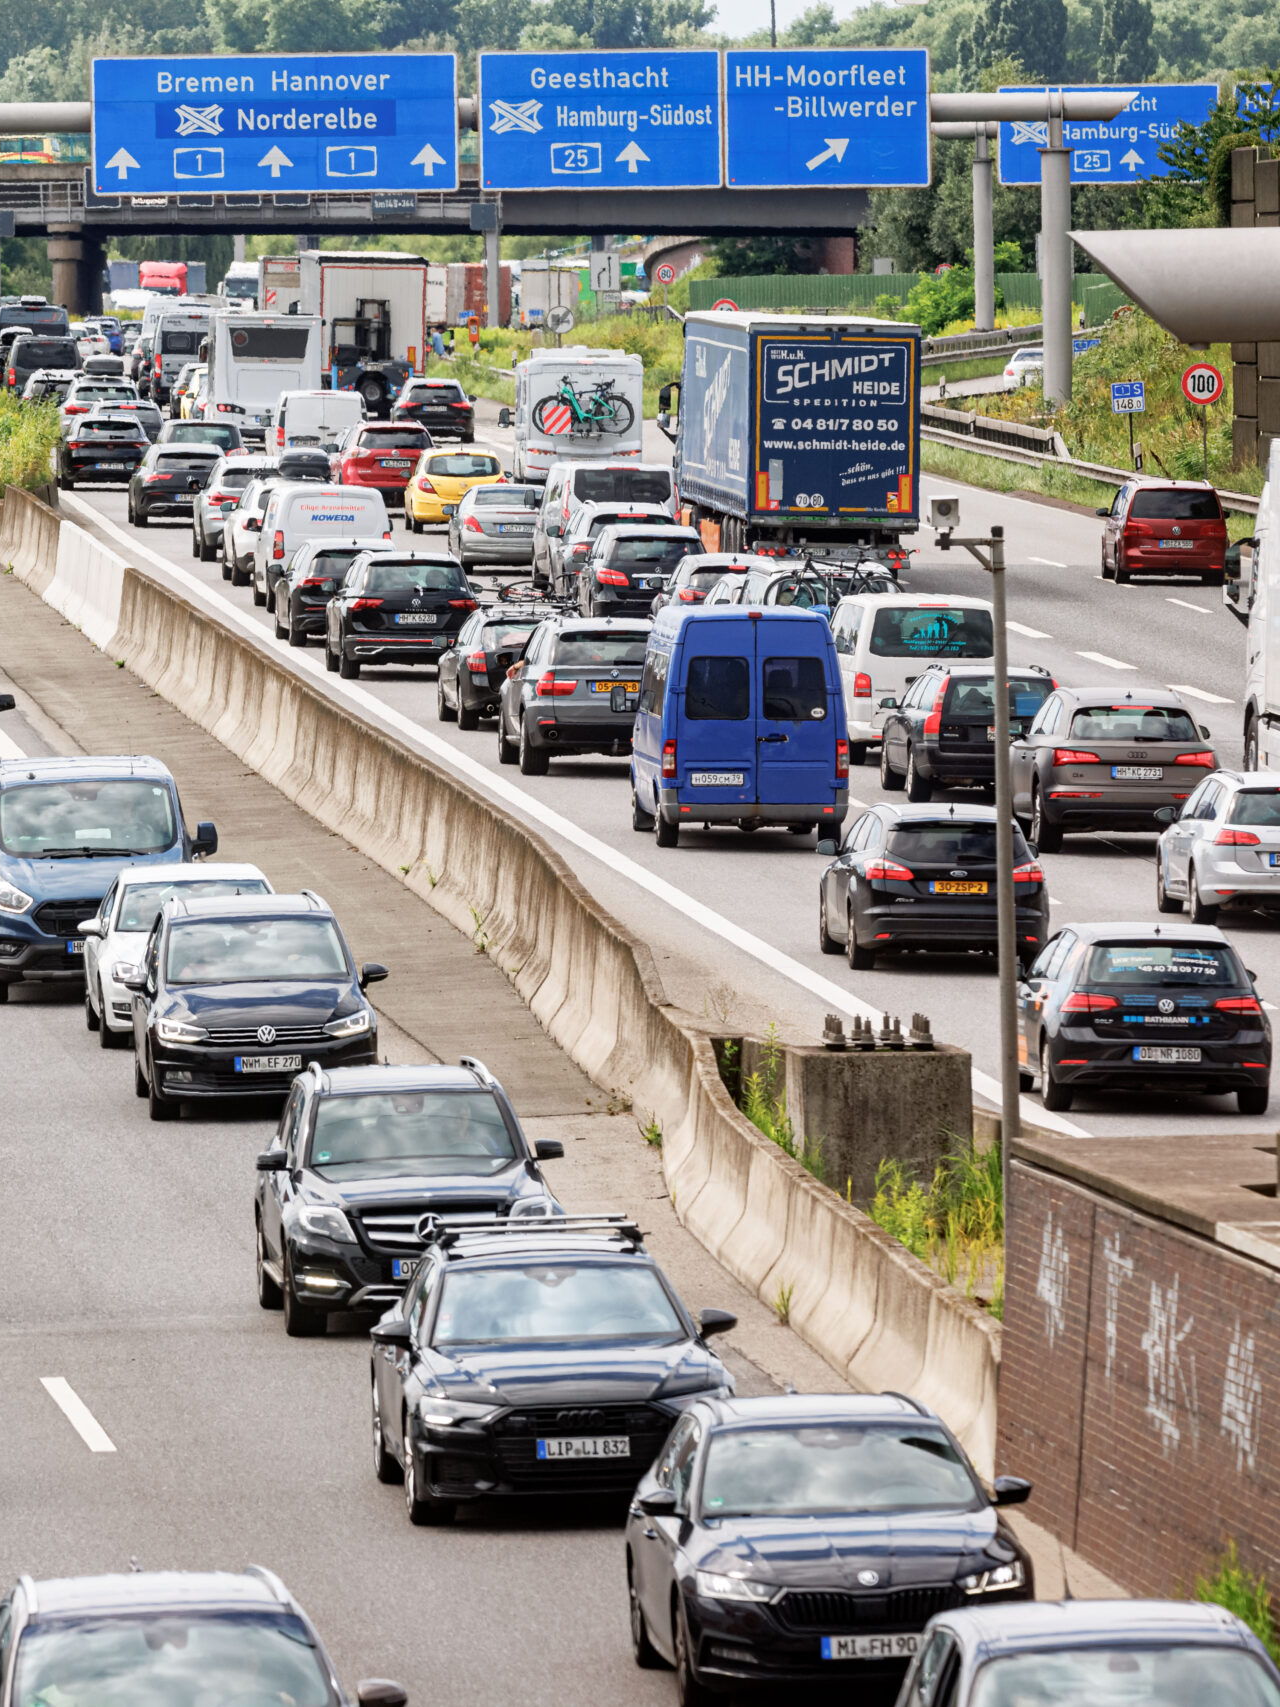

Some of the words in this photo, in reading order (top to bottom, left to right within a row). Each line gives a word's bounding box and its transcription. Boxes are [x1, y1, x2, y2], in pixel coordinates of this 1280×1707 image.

[157, 71, 254, 93] Bremen
[271, 70, 390, 91] Hannover
[531, 66, 669, 89] Geesthacht
[735, 65, 906, 87] HH-Moorfleet
[774, 95, 917, 117] -Billwerder
[237, 107, 378, 131] Norderelbe
[556, 104, 712, 132] Hamburg-Südost
[195, 153, 202, 172] 1
[348, 152, 355, 171] 1
[564, 149, 588, 168] 25
[1083, 154, 1101, 168] 25
[776, 353, 895, 394] SCHMIDT
[852, 381, 900, 395] HEIDE
[1133, 384, 1141, 395] S
[1190, 374, 1215, 393] 100
[793, 399, 878, 407] SPEDITION
[1116, 398, 1141, 410] 148.0
[791, 418, 813, 430] 04
[816, 418, 849, 431] 81/7
[852, 419, 874, 431] 80
[877, 419, 898, 431] 50
[763, 439, 906, 451] www.schmidt-heide.de
[311, 514, 355, 522] NOWEDA
[1117, 768, 1127, 776] HH
[1131, 768, 1141, 776] KC
[1143, 768, 1162, 777] 2731
[938, 882, 984, 892] 30-ZSP-2
[1144, 1016, 1189, 1024] RATHMANN
[1140, 1048, 1154, 1059] OD
[1160, 1049, 1173, 1059] NR
[1175, 1049, 1200, 1059] 1080
[242, 1059, 261, 1069] NWM
[267, 1058, 279, 1068] EF
[283, 1056, 301, 1067] 270
[547, 1442, 574, 1457] LIP
[582, 1441, 600, 1455] LI
[603, 1440, 628, 1455] 832
[837, 1639, 858, 1656] MI
[869, 1638, 893, 1654] FH
[895, 1636, 918, 1653] 90
